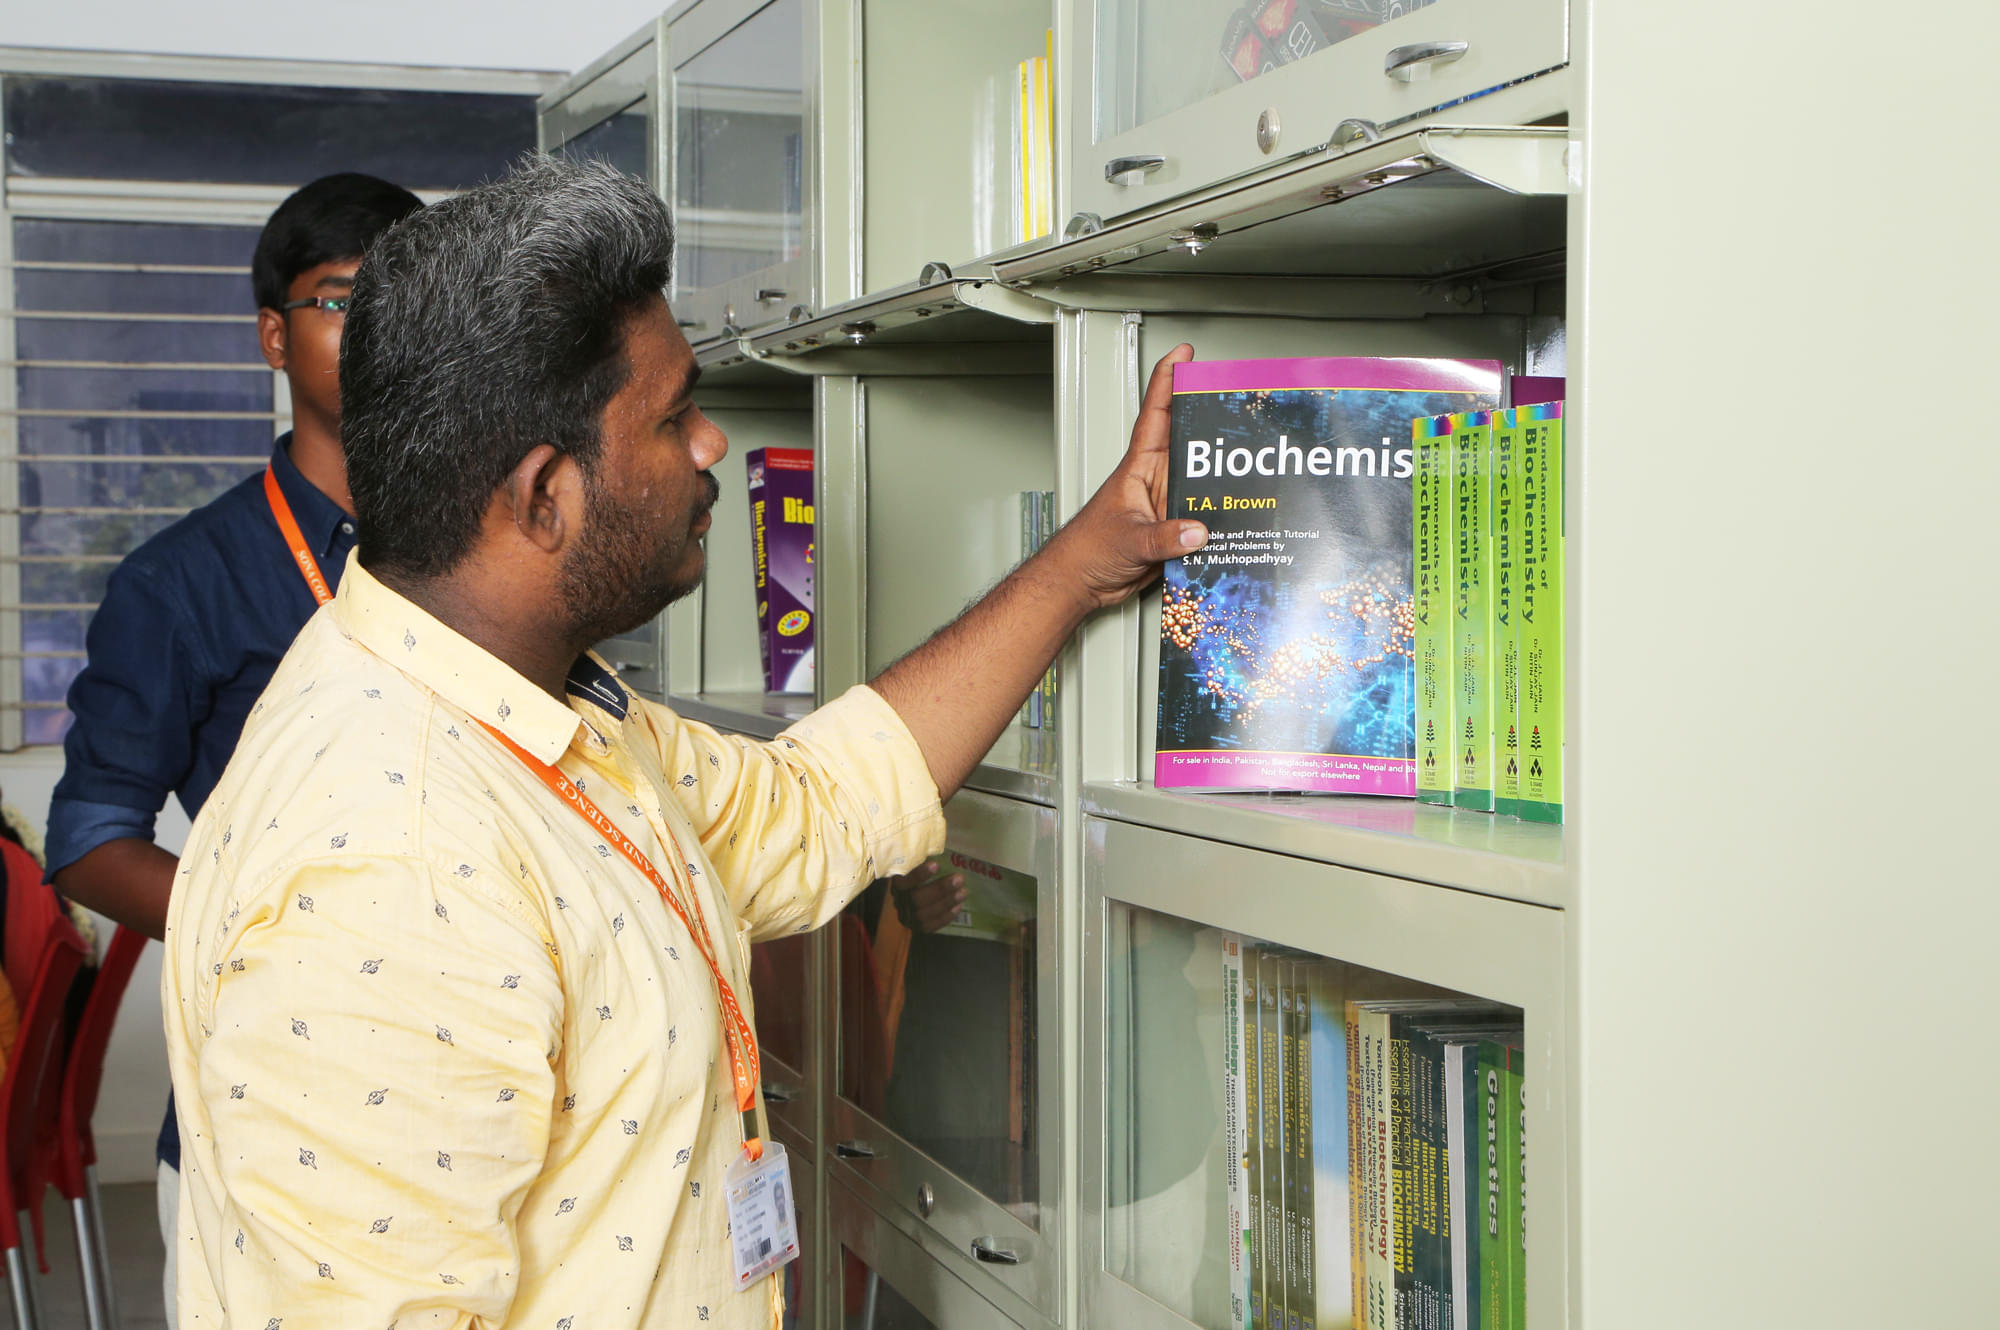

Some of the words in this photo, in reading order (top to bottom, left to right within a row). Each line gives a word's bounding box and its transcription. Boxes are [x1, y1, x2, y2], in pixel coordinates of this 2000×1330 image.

[1187, 497, 1198, 511] T.
[1201, 496, 1217, 511] A.
[1223, 496, 1277, 510] Brown
[1227, 530, 1244, 539] and
[1246, 530, 1281, 538] Practice
[1284, 530, 1320, 539] Tutorial
[1419, 445, 1431, 626] Biochemistry
[1458, 434, 1470, 621] Biochemistry
[1499, 435, 1512, 626] Biochemistry
[1522, 428, 1538, 624] Biochemistry
[1207, 553, 1294, 566] Mukhopadhyay
[1230, 542, 1270, 551] Problems
[1274, 542, 1285, 552] by
[1434, 575, 1440, 594] of
[1473, 568, 1480, 587] of
[1540, 569, 1548, 589] of
[1172, 756, 1184, 764] For
[1186, 756, 1201, 764] sale
[1212, 756, 1232, 764] India,
[1322, 760, 1333, 768] Sri
[1335, 762, 1360, 771] Lanka,
[1362, 762, 1386, 773] Nepal
[1320, 770, 1360, 780] elsewhere
[556, 776, 622, 843] SCIENCE
[624, 841, 652, 872] AND
[1229, 969, 1238, 1076] Biotechnology
[1347, 1075, 1354, 1088] of
[1391, 1039, 1401, 1094] Essentials
[1366, 1096, 1372, 1110] of
[1378, 1101, 1384, 1114] of
[1392, 1098, 1402, 1113] of
[1392, 1115, 1402, 1164] Practical
[1487, 1070, 1499, 1235] Genetics
[1378, 1120, 1388, 1260] Biotechnology
[1422, 1142, 1430, 1230] Biochemistry
[1429, 1146, 1437, 1235] Biochemistry
[1394, 1169, 1404, 1273] BIOCHEMISTRY
